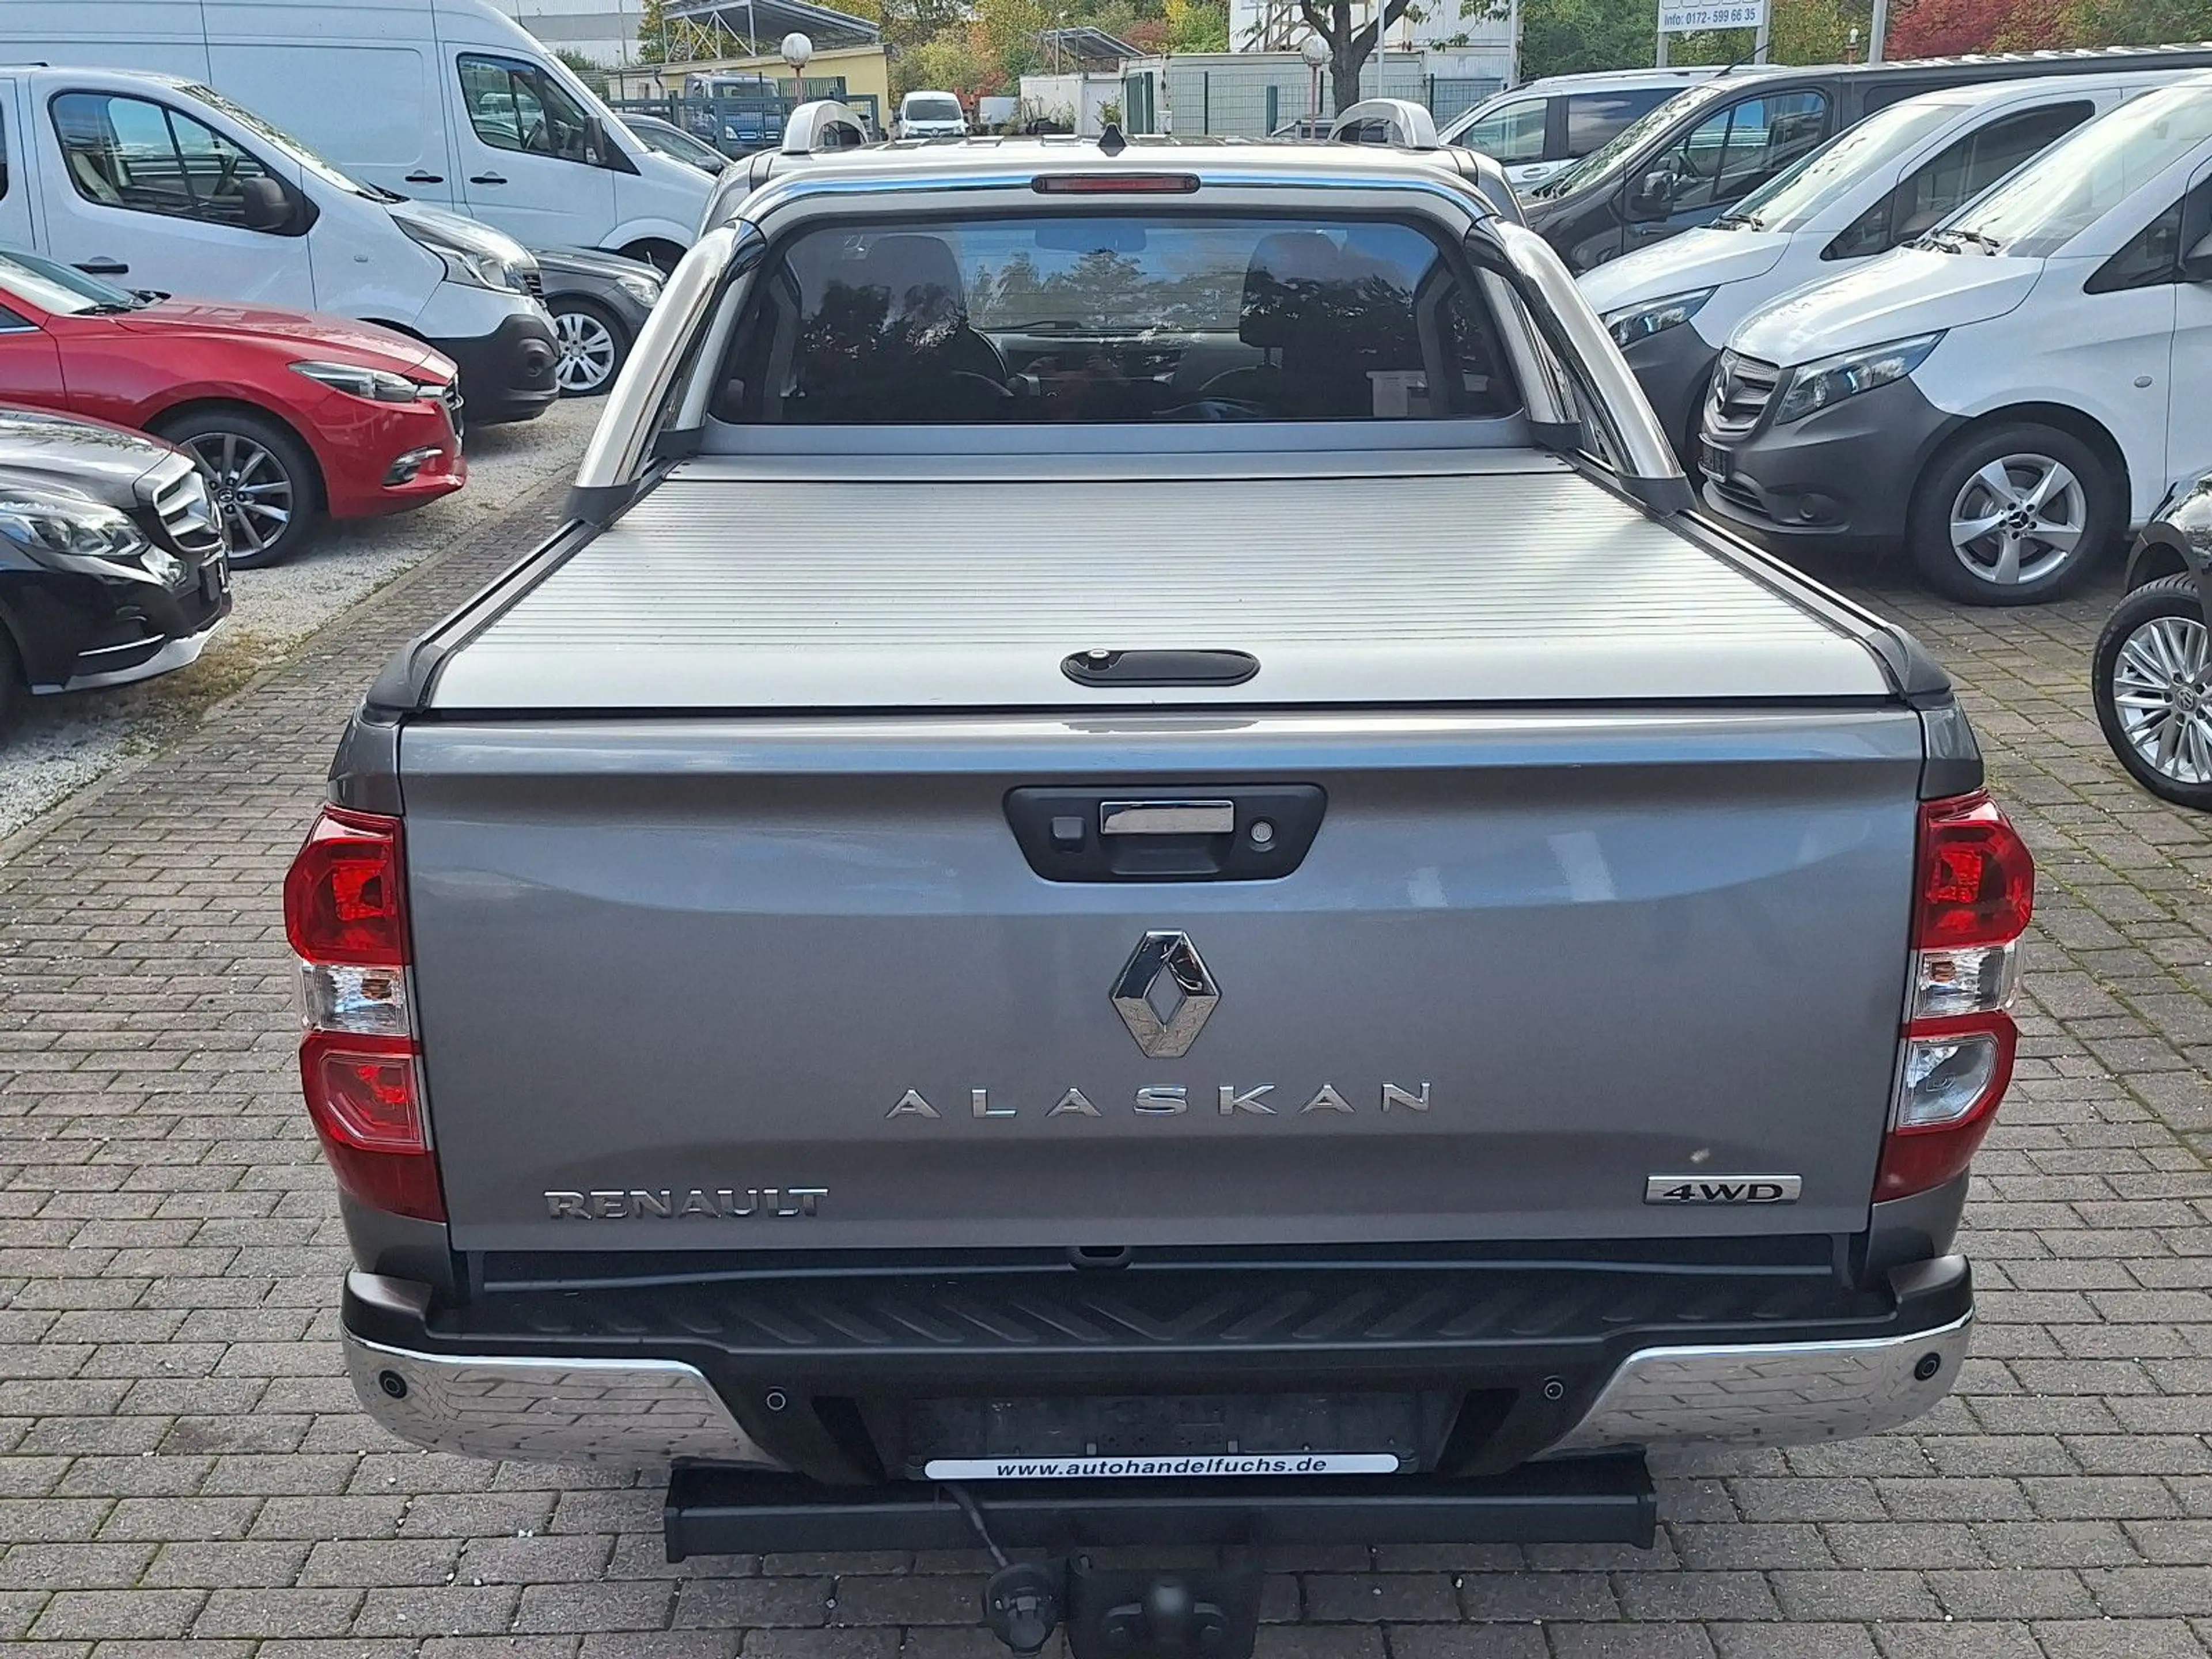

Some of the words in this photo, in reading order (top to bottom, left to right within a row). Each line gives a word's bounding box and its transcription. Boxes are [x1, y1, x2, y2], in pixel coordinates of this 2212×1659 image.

[1664, 14, 1683, 25] Info:
[1713, 10, 1728, 22] 599
[1730, 9, 1742, 21] 66
[1744, 8, 1755, 20] 35
[885, 1082, 1431, 1118] ALASKAN
[1663, 1184, 1783, 1202] 4WD
[543, 1188, 828, 1219] RENAULT
[996, 1456, 1327, 1476] www.autohandelfuchs.de
